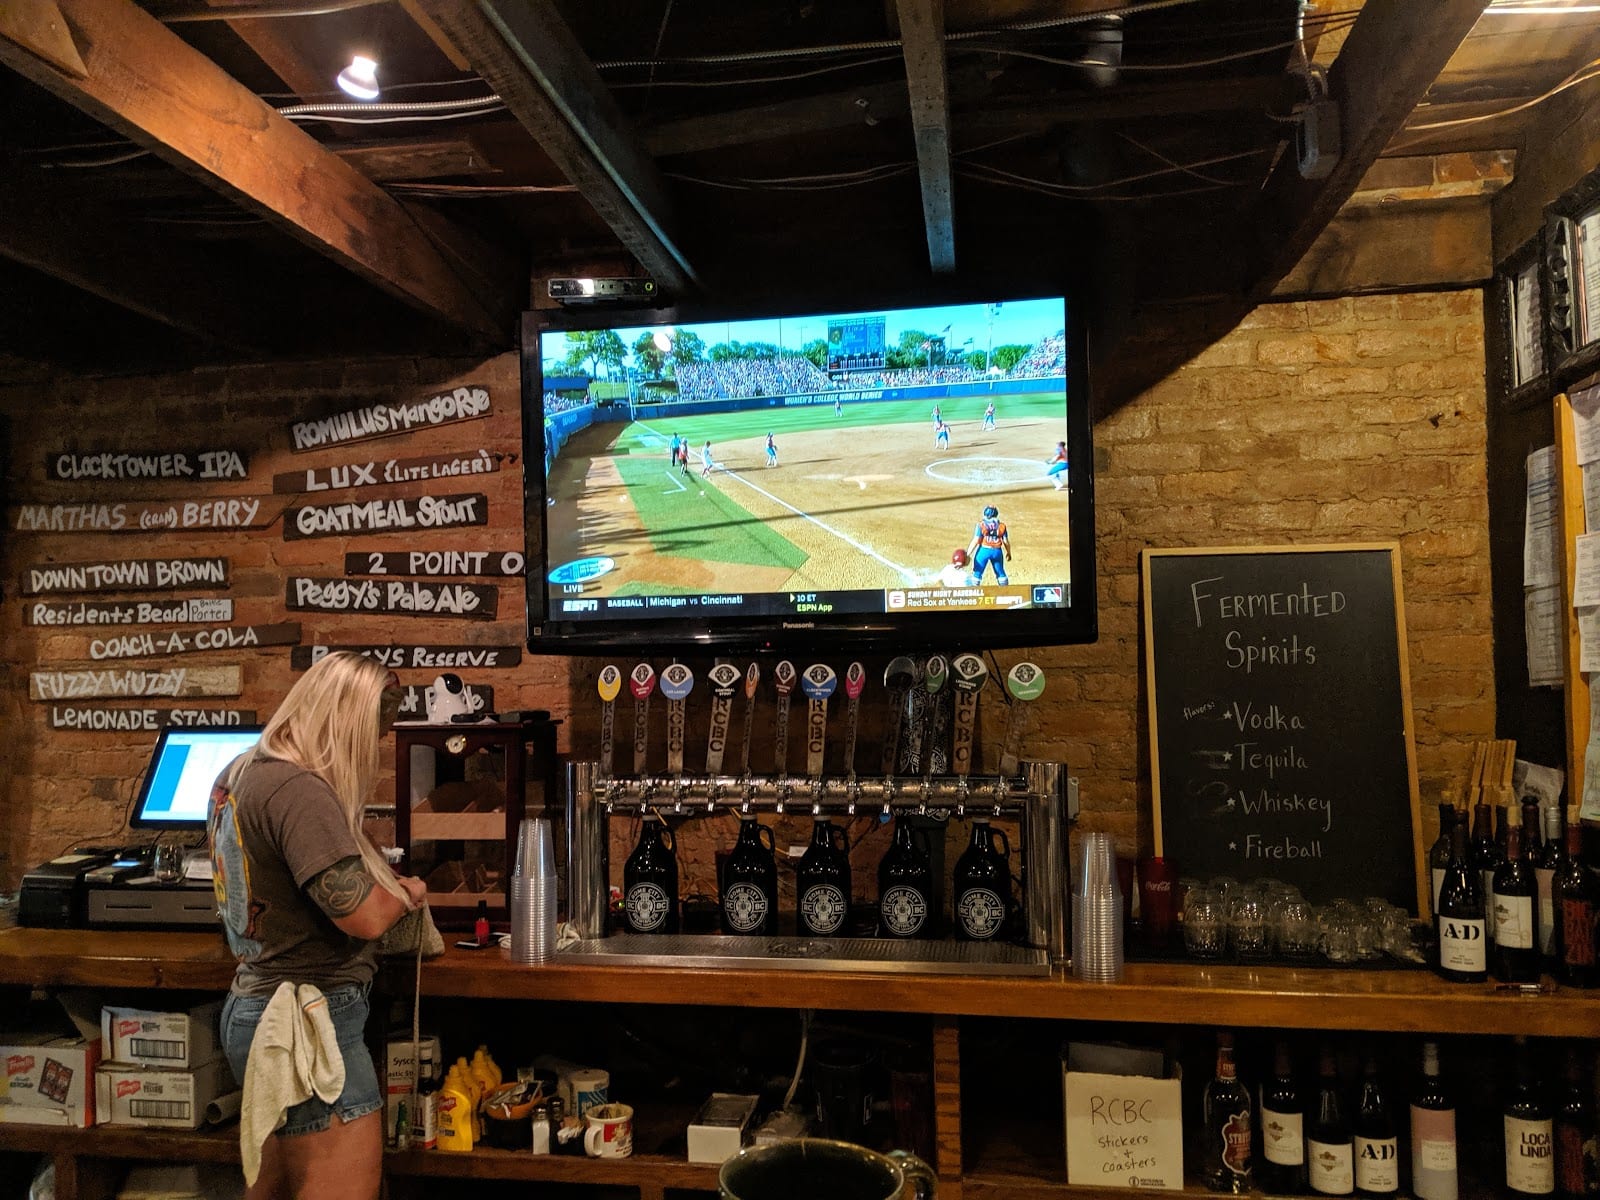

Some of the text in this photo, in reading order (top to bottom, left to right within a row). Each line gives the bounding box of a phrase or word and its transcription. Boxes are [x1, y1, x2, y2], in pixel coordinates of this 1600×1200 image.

[292, 405, 391, 449] ROMULUS
[56, 451, 246, 479] CLOCKTOWER IPA
[306, 462, 378, 491] LUX
[17, 504, 127, 531] MARTHAS
[182, 499, 259, 527] BERRY
[296, 498, 415, 535] GOATMEAL
[156, 559, 225, 586] BROWN
[368, 552, 387, 574] 2
[409, 551, 489, 574] POINT
[295, 577, 480, 614] Peggy's Pale Ale
[563, 585, 584, 593] LIVE
[607, 599, 643, 607] BASEBALL
[650, 597, 687, 607] Michigan
[701, 595, 743, 605] Cincinnati
[806, 594, 817, 602] ET
[907, 589, 985, 599] SUNDAY NIGHT BASEBALL
[137, 601, 189, 623] Beard
[191, 605, 228, 622] Porter
[563, 600, 598, 612] ESPN
[796, 603, 833, 613] ESPN App
[907, 597, 995, 607] Red Sox at Yankees 7 ET
[783, 622, 815, 630] Panasonic
[412, 647, 499, 667] RESERVE
[33, 668, 186, 698] FUZZY WUZZY
[1233, 701, 1305, 732] Vodka
[1234, 742, 1309, 779] Tequila
[1239, 788, 1331, 832] Whiskey
[1245, 834, 1322, 859] Fireball
[1090, 1096, 1152, 1126] RCBC
[1521, 1132, 1550, 1146] LOCA
